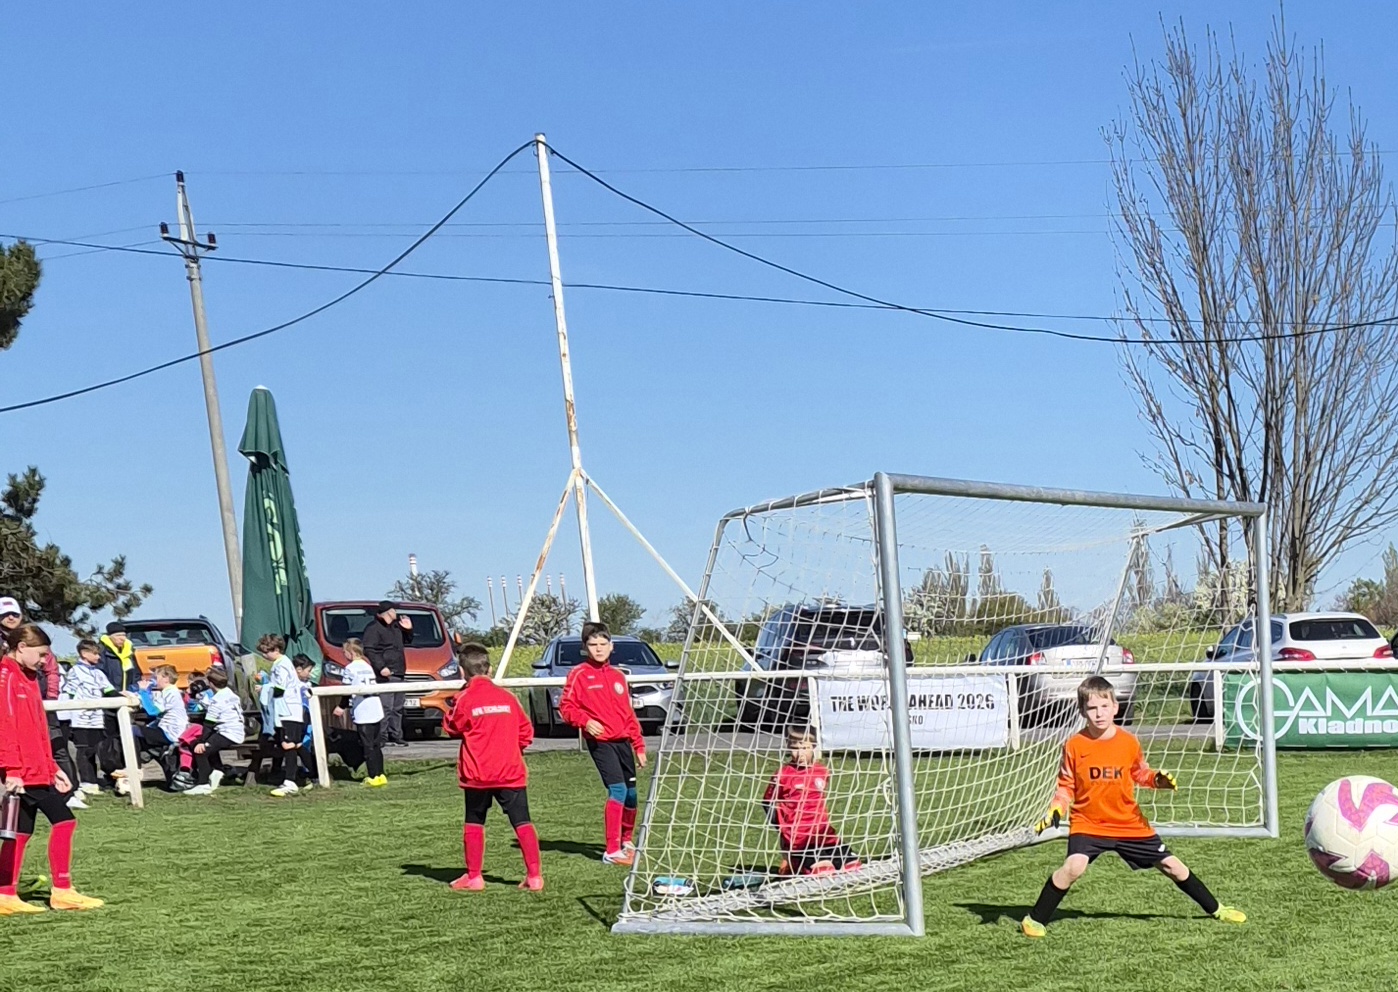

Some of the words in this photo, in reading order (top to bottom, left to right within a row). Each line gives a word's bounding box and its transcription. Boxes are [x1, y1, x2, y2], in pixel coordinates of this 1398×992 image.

[830, 695, 854, 712] THE
[908, 693, 953, 711] AHEAD
[957, 693, 995, 711] 2026
[1089, 766, 1124, 780] DEK
